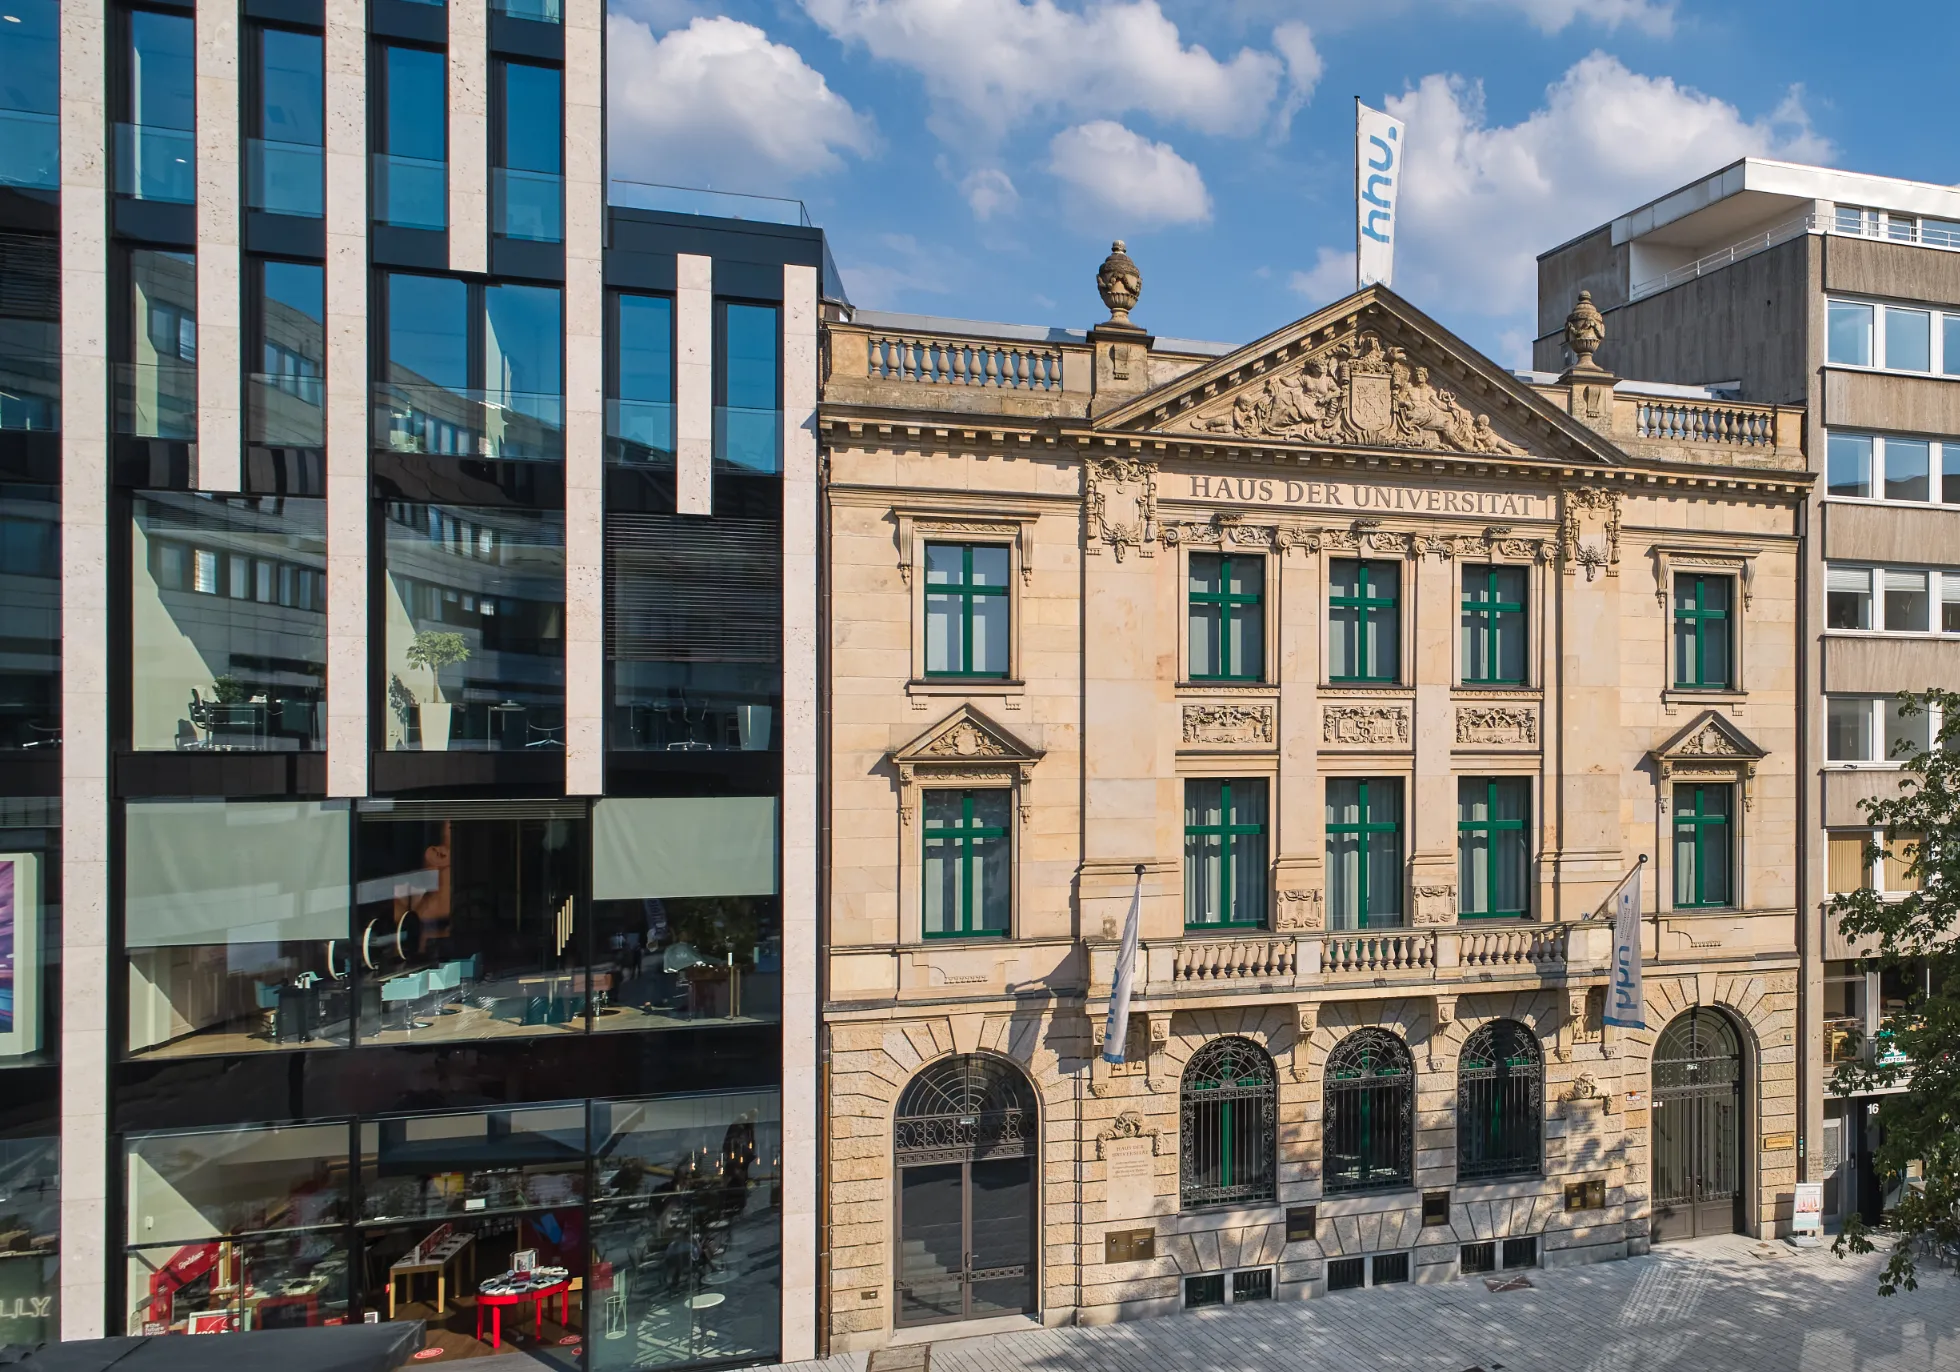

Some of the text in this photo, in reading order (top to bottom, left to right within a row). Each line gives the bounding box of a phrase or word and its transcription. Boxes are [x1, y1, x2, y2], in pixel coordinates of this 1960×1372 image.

[1189, 475, 1535, 516] HAUS DER UNIVERSITÄT
[1867, 1103, 1880, 1115] 16
